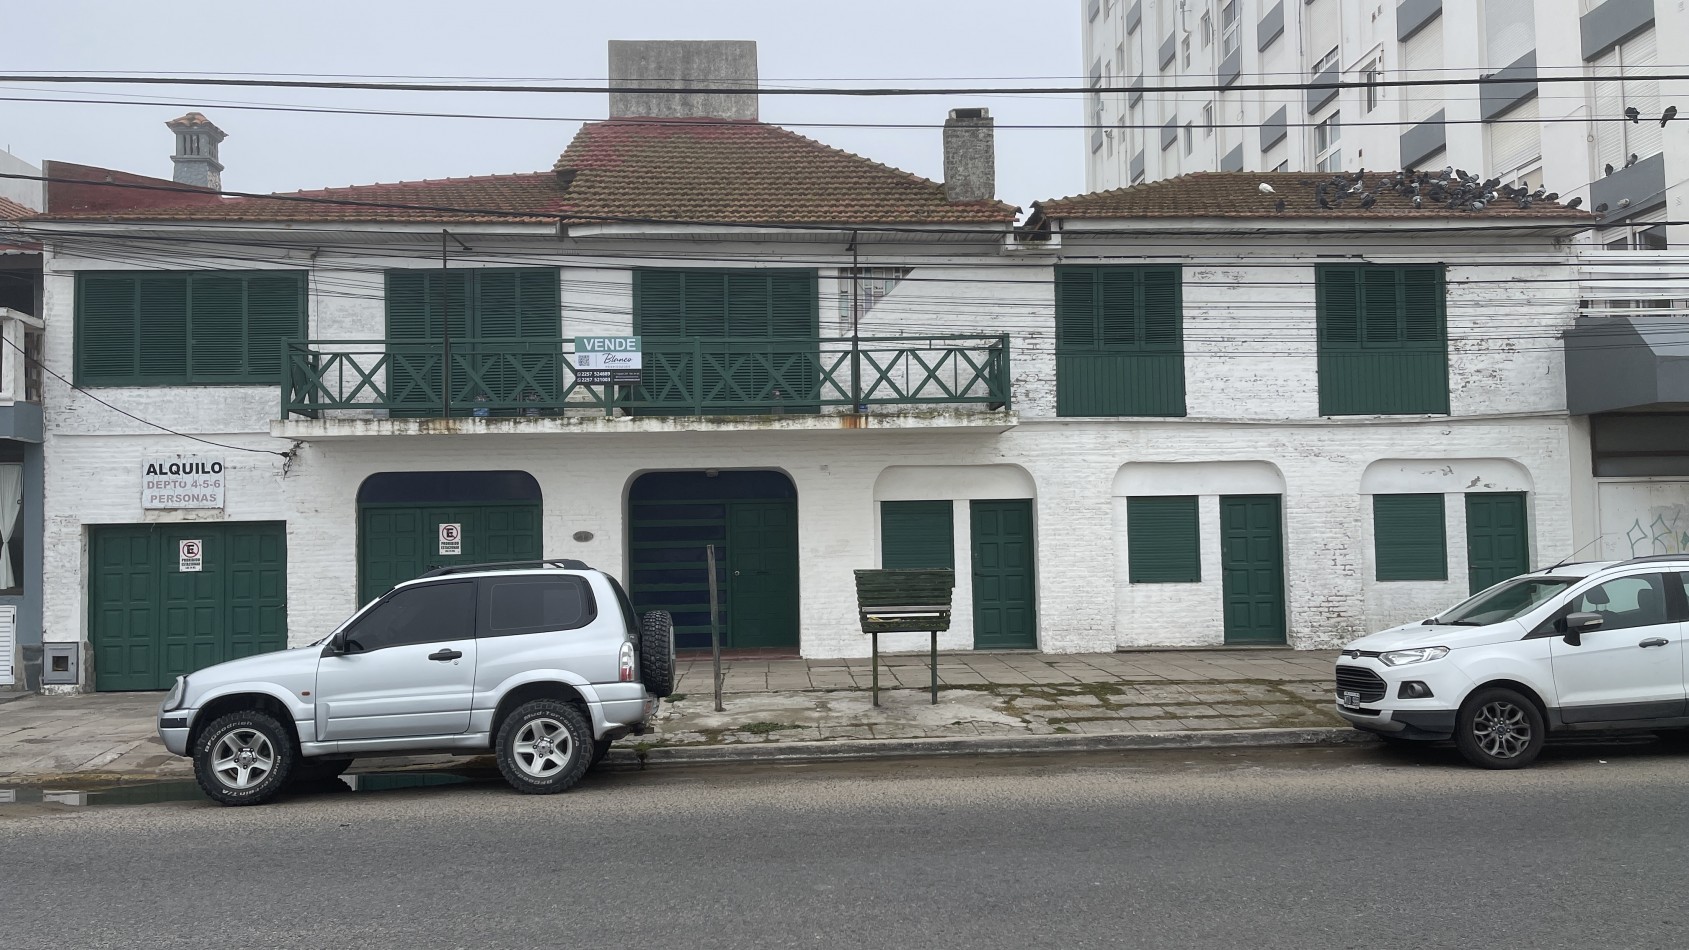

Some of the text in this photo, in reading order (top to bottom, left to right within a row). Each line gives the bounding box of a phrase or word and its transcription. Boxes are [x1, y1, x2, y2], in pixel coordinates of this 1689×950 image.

[583, 338, 636, 351] VENDE
[602, 352, 632, 364] Blanco
[146, 462, 223, 476] ALQUILO
[147, 479, 221, 490] DEPTO 4-5-6
[150, 493, 217, 503] PERSONAS
[204, 721, 253, 753] BFGoodrich
